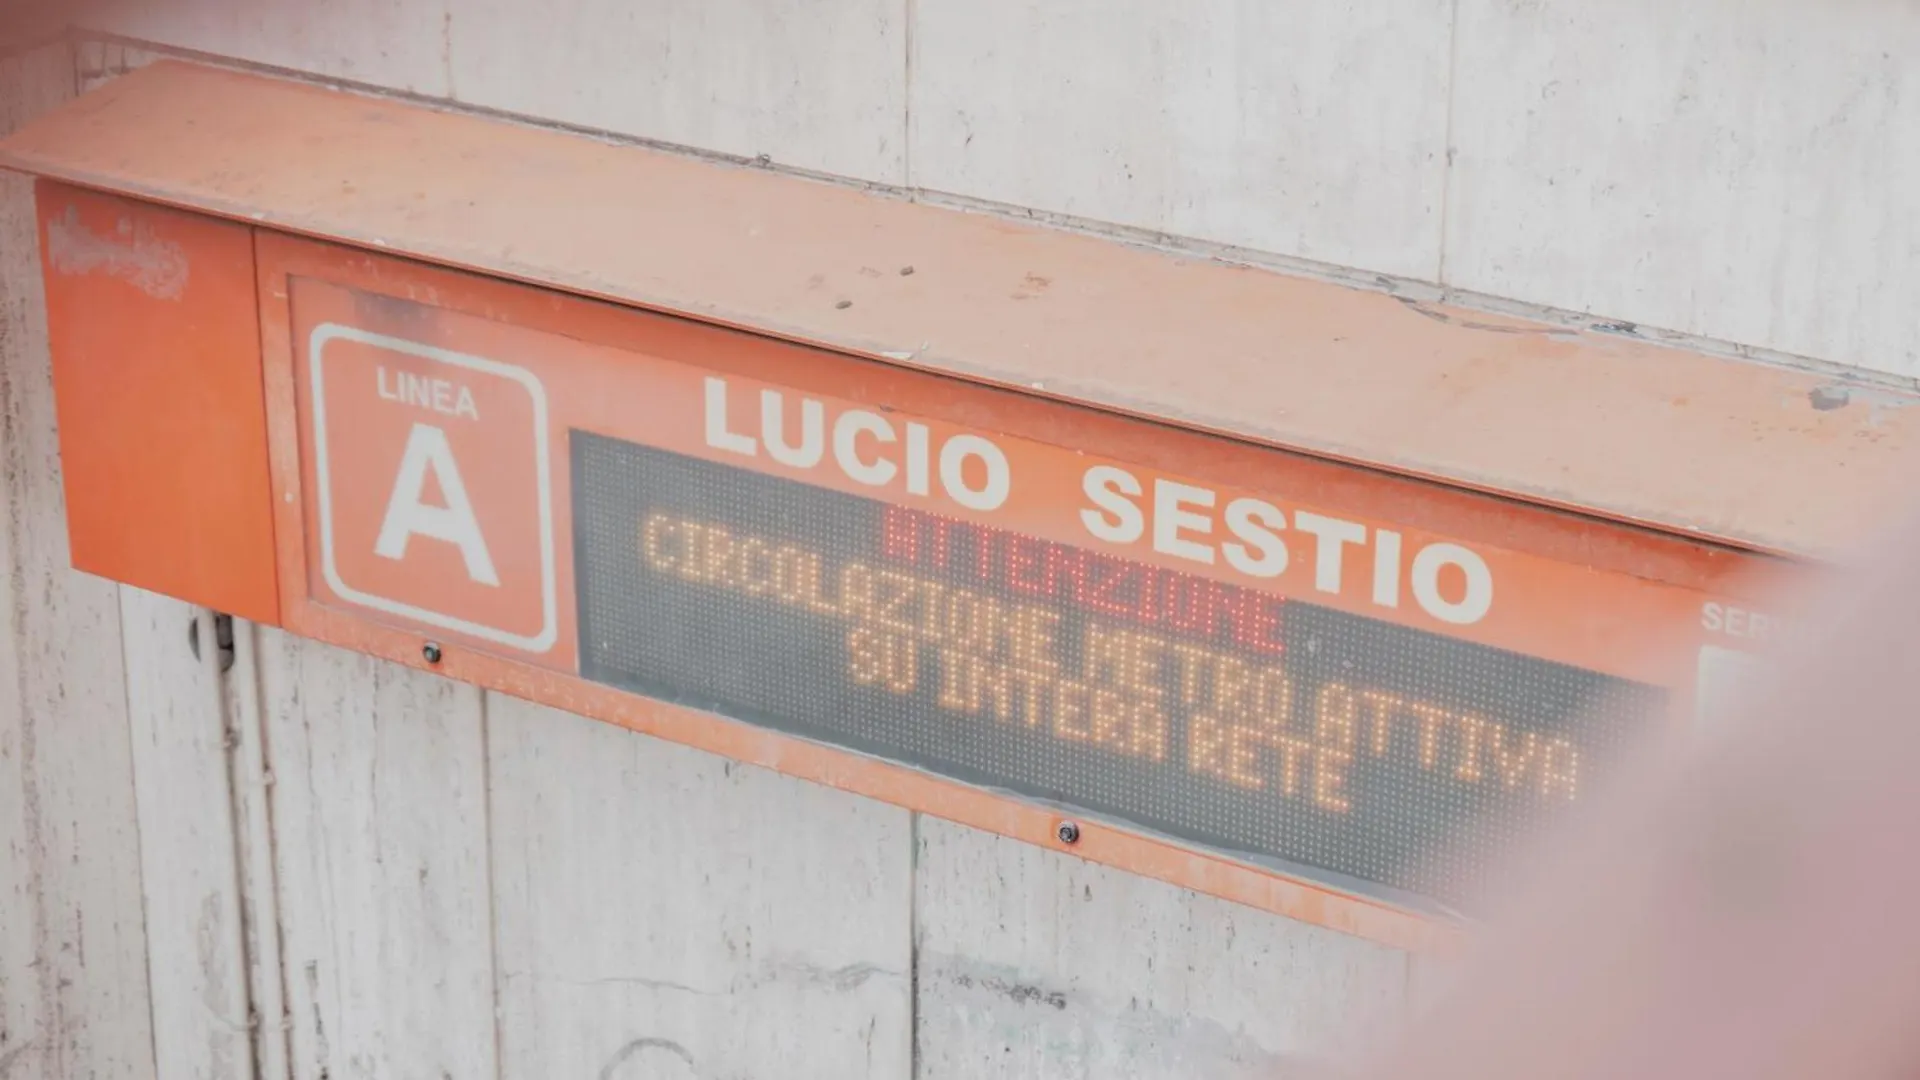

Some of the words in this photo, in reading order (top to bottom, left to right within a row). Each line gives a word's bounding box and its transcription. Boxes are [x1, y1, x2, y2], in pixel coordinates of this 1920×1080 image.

[376, 366, 480, 421] LINEA
[374, 422, 501, 588] A
[704, 377, 1011, 512] LUCIO
[1080, 465, 1494, 625] SESTIO
[883, 503, 1287, 653] ATTENZIONE
[644, 513, 1062, 672] CIRCOLAZIONE
[1089, 621, 1289, 726] METRO
[1317, 681, 1579, 801] ATTIVA
[1700, 601, 1770, 639] SER
[849, 626, 916, 691] SU
[942, 649, 1164, 761] INTERA
[1193, 714, 1352, 808] RETE
